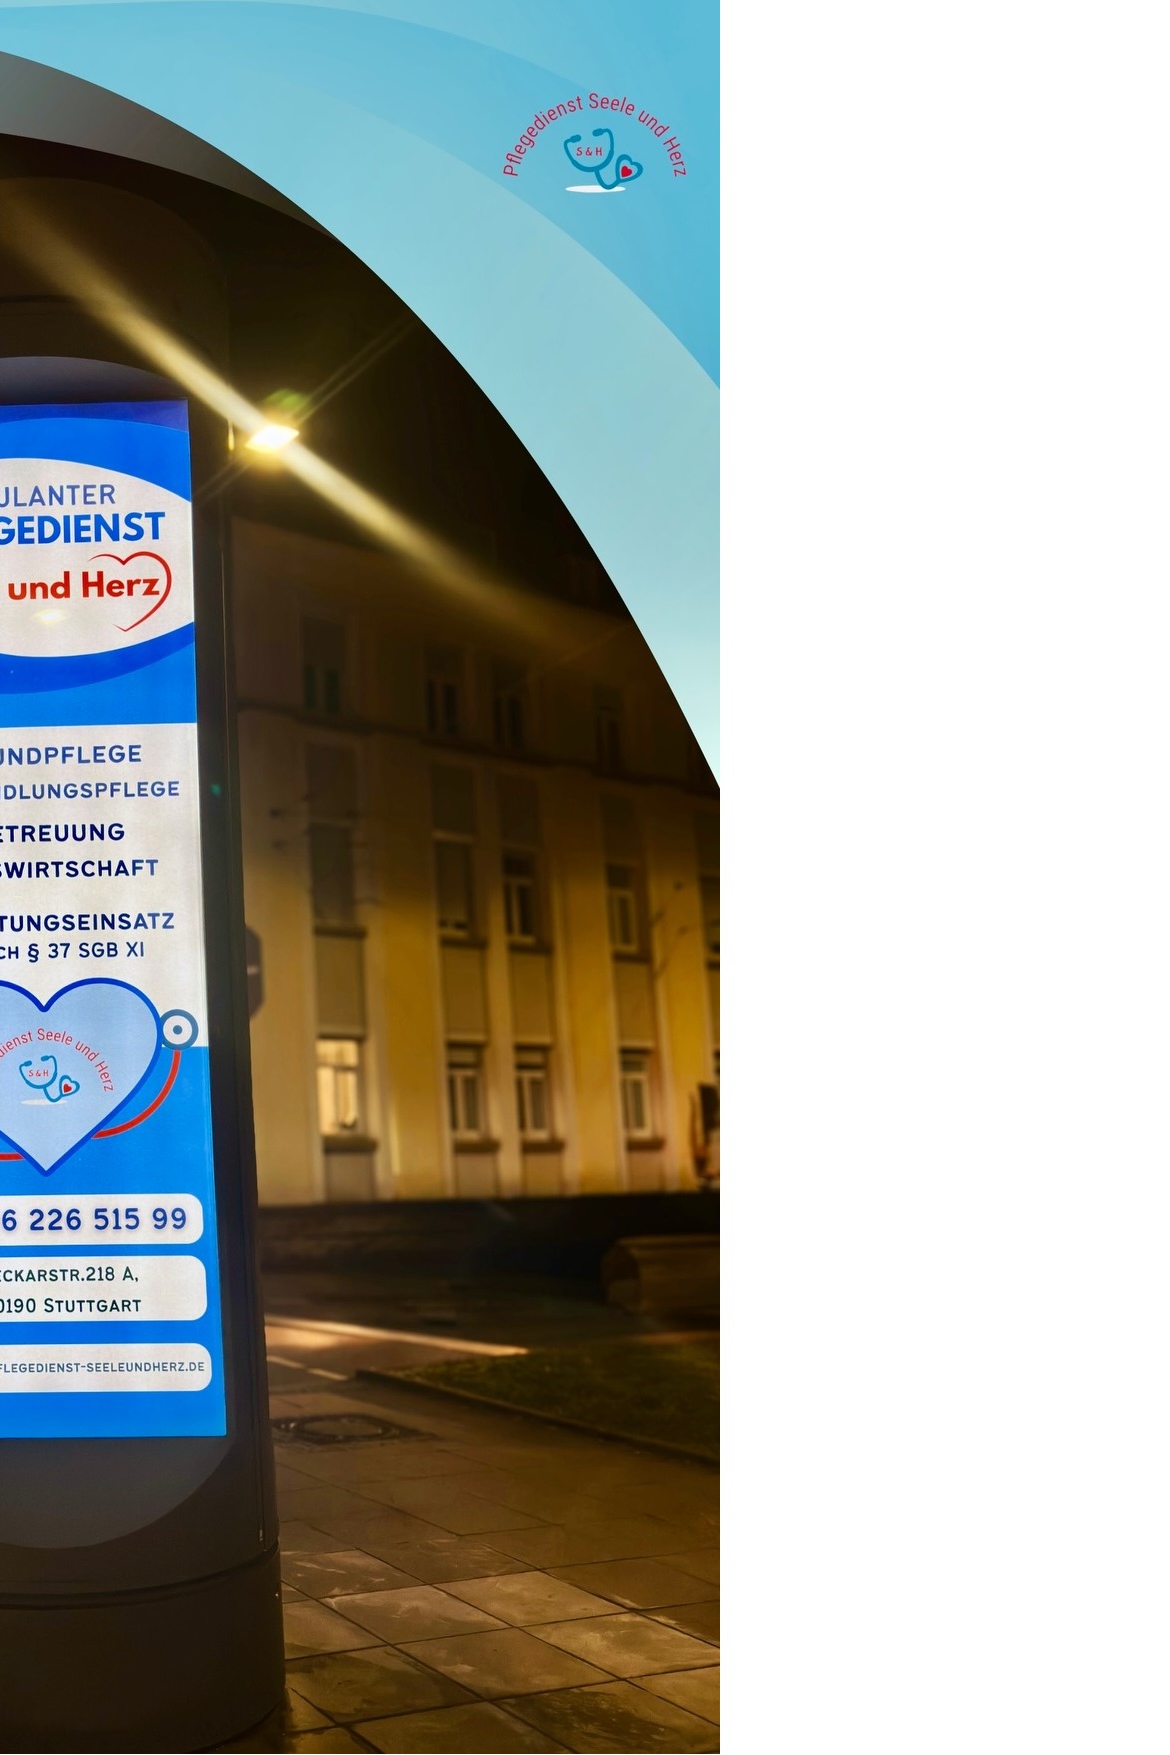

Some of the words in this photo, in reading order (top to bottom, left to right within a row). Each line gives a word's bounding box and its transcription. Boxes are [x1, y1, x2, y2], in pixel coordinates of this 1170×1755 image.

[8, 571, 70, 600] und
[81, 570, 161, 598] Herz
[28, 942, 40, 963] §
[48, 942, 71, 960] 37
[78, 941, 119, 959] SGB
[126, 941, 145, 958] XI
[36, 1027, 74, 1046] Seele
[74, 1040, 101, 1063] und
[94, 1060, 115, 1093] Herz
[29, 1208, 82, 1231] 226
[94, 1207, 140, 1230] 515
[152, 1207, 187, 1230] 99
[122, 1266, 139, 1283] A,
[43, 1298, 142, 1313] STUTTGART
